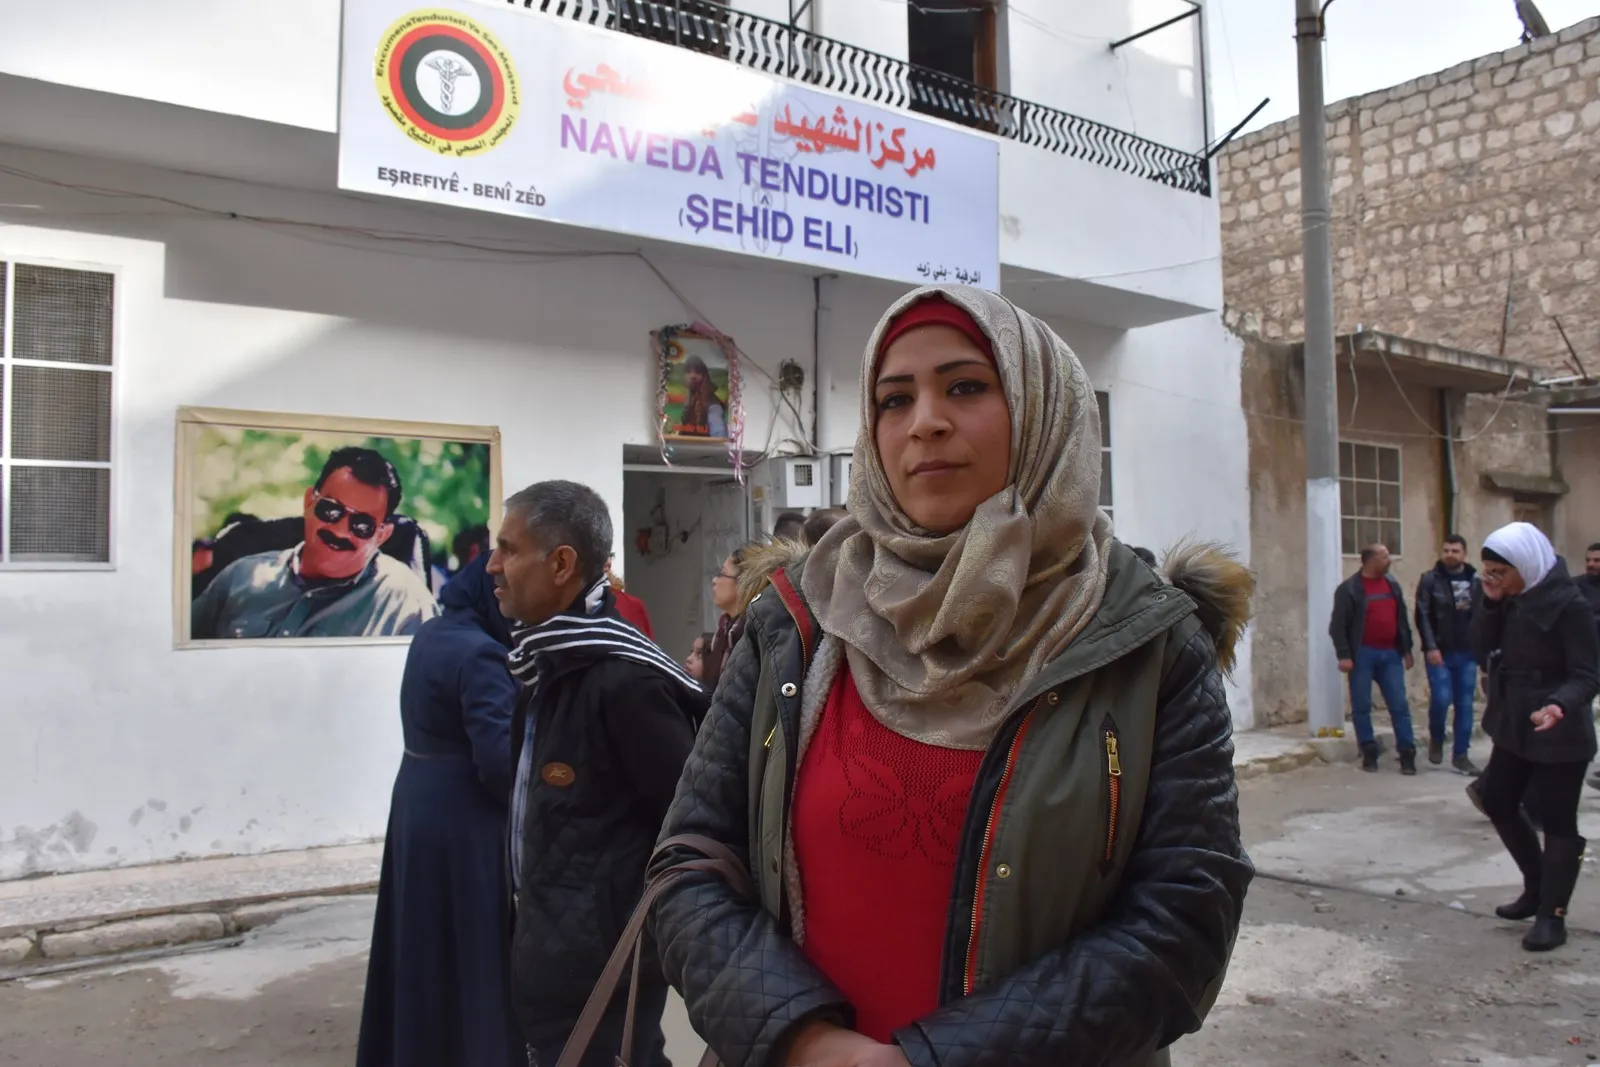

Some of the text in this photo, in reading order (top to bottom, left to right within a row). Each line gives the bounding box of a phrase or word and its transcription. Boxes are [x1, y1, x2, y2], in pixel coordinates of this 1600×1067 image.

[438, 141, 452, 154] في
[773, 103, 873, 156] الشهيد
[870, 120, 936, 177] مركز
[473, 180, 513, 201] BENÎ
[515, 185, 547, 207] ZÊD
[560, 113, 723, 180] NAVEDA
[736, 152, 930, 224] TENDURISTI
